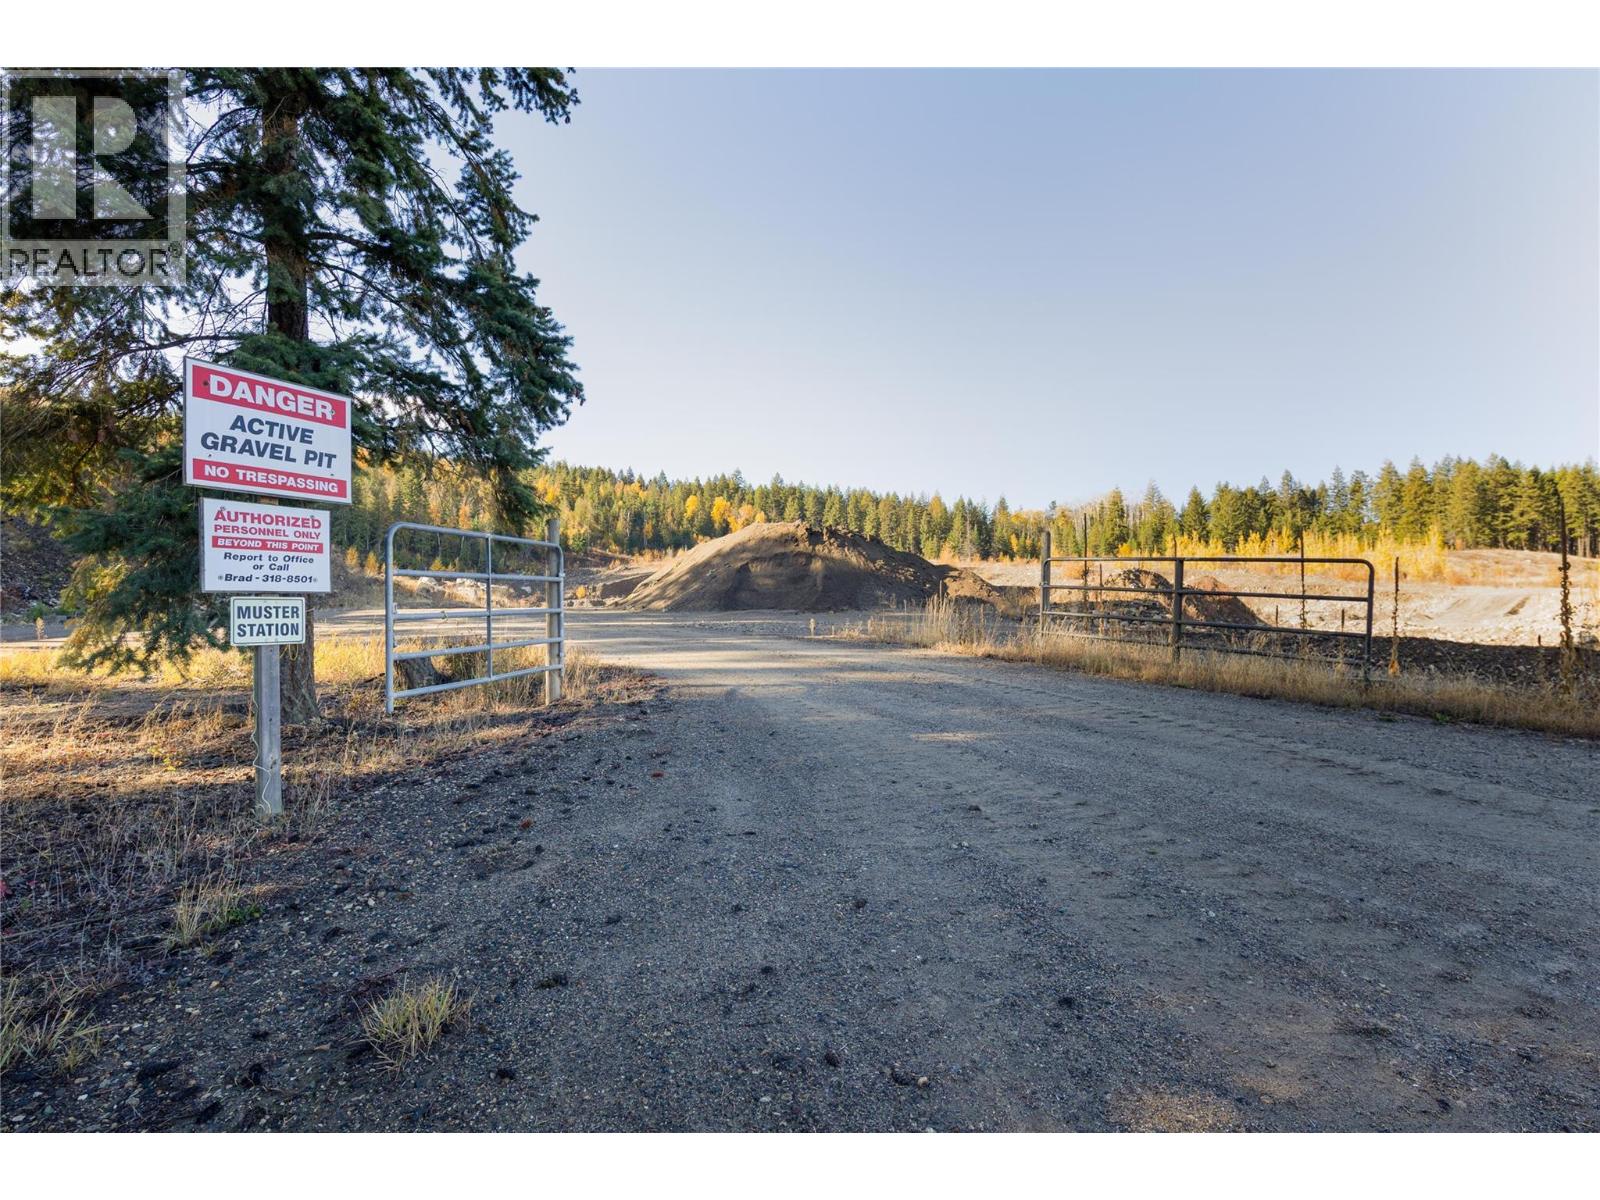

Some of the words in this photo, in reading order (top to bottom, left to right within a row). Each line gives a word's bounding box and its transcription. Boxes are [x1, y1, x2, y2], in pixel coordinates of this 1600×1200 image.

[209, 374, 333, 421] DANGER
[229, 415, 314, 445] ACTIVE
[201, 432, 296, 463] GRAVEL
[304, 449, 337, 469] PIT
[204, 464, 230, 478] NO
[236, 468, 339, 493] TRESPASSING
[214, 510, 322, 529] AUTHORIZED
[214, 524, 289, 538] PERSONNEL
[293, 530, 321, 540] ONLY
[217, 538, 262, 548] BEYOND
[266, 541, 288, 550] THIS
[291, 543, 320, 551] POINT
[224, 552, 263, 563] Report
[268, 554, 279, 562] to
[283, 555, 314, 564] Office
[269, 563, 290, 571] Call
[224, 574, 253, 583] Brad
[237, 606, 300, 620] MUSTER
[237, 623, 300, 638] STATION
